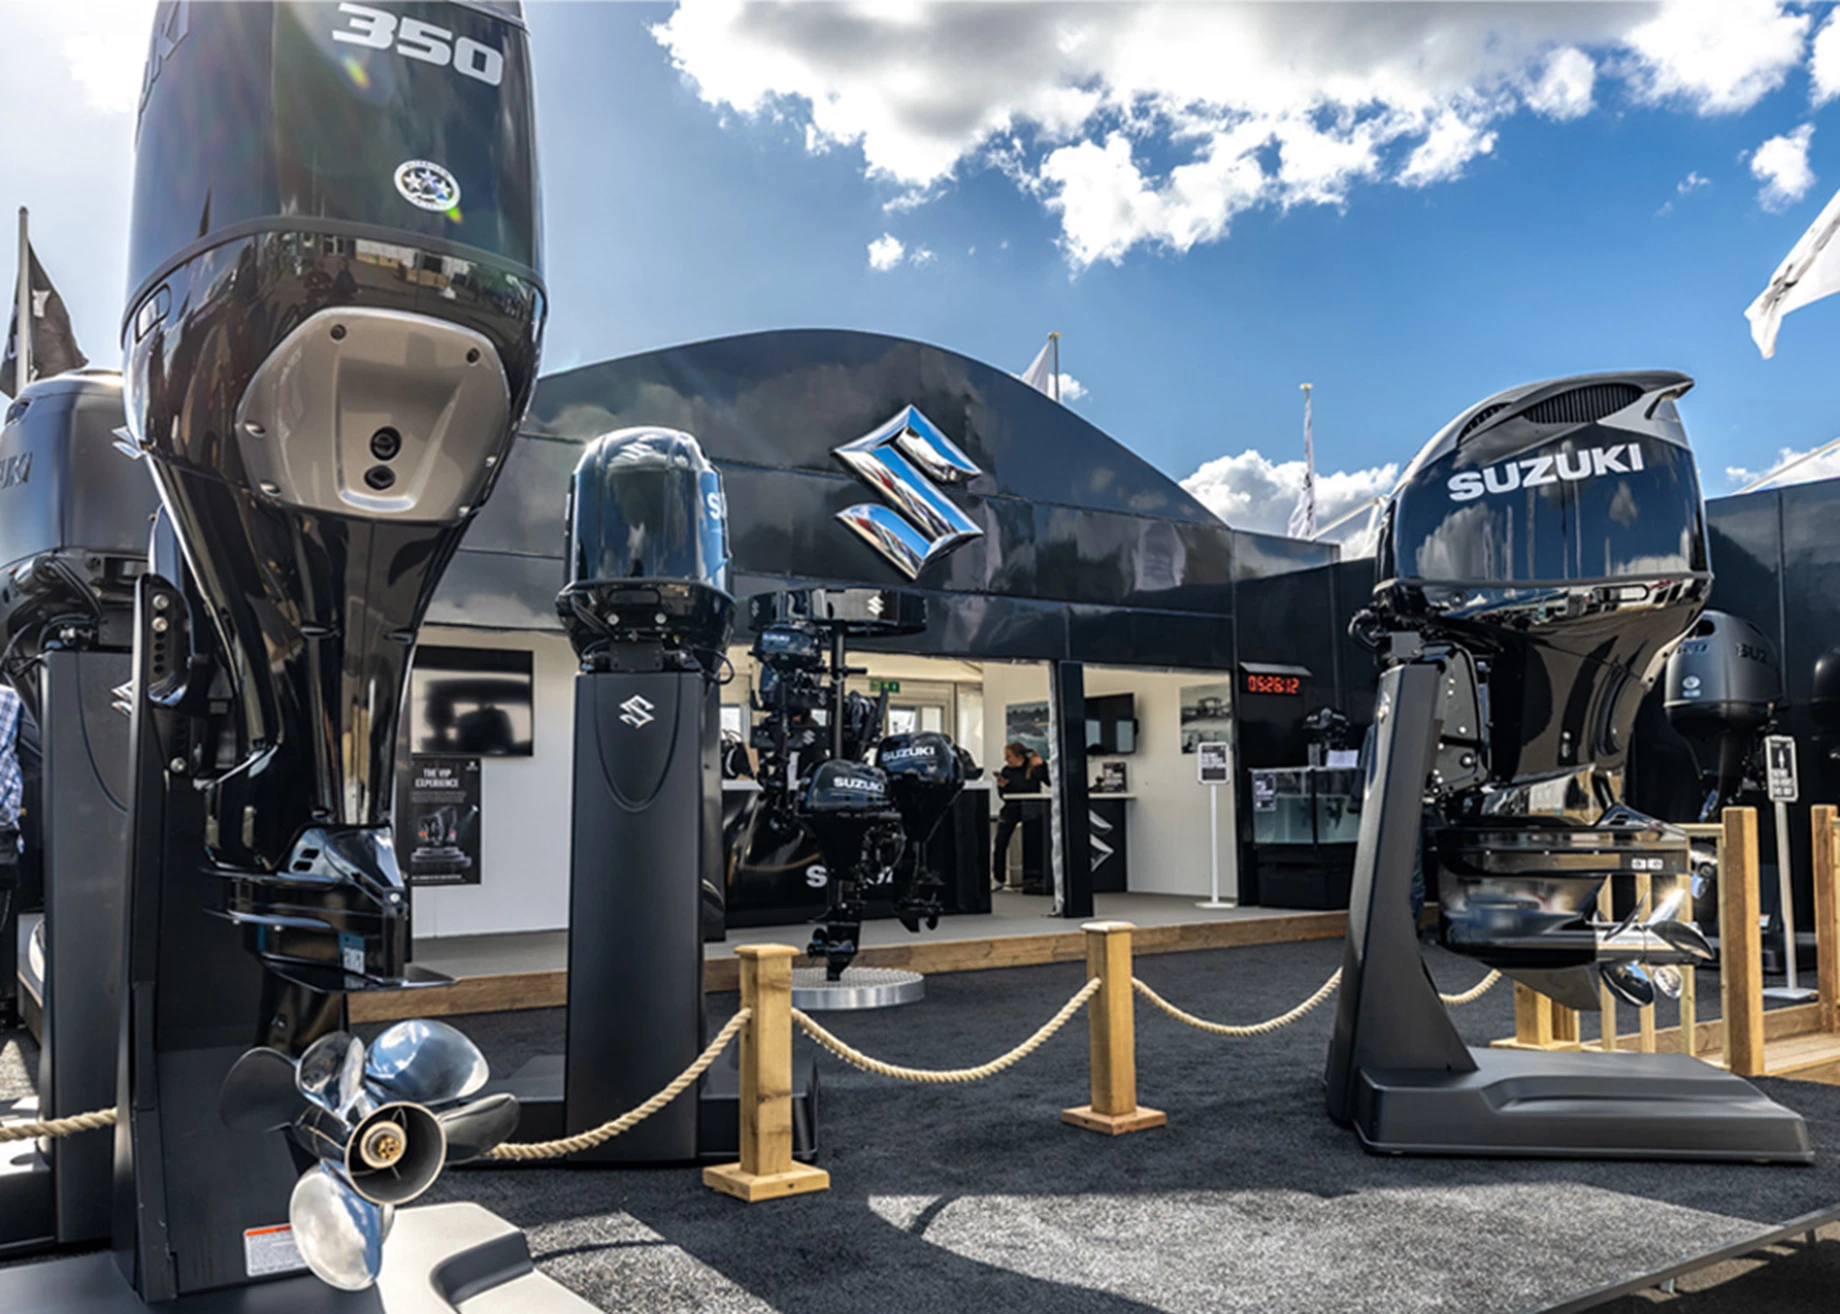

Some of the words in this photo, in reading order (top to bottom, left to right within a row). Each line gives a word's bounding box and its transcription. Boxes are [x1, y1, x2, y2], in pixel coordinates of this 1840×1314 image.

[332, 2, 503, 86] 350
[1447, 442, 1645, 501] SUZUKI
[882, 746, 935, 761] SUZUKI
[833, 777, 885, 793] SUZUKI
